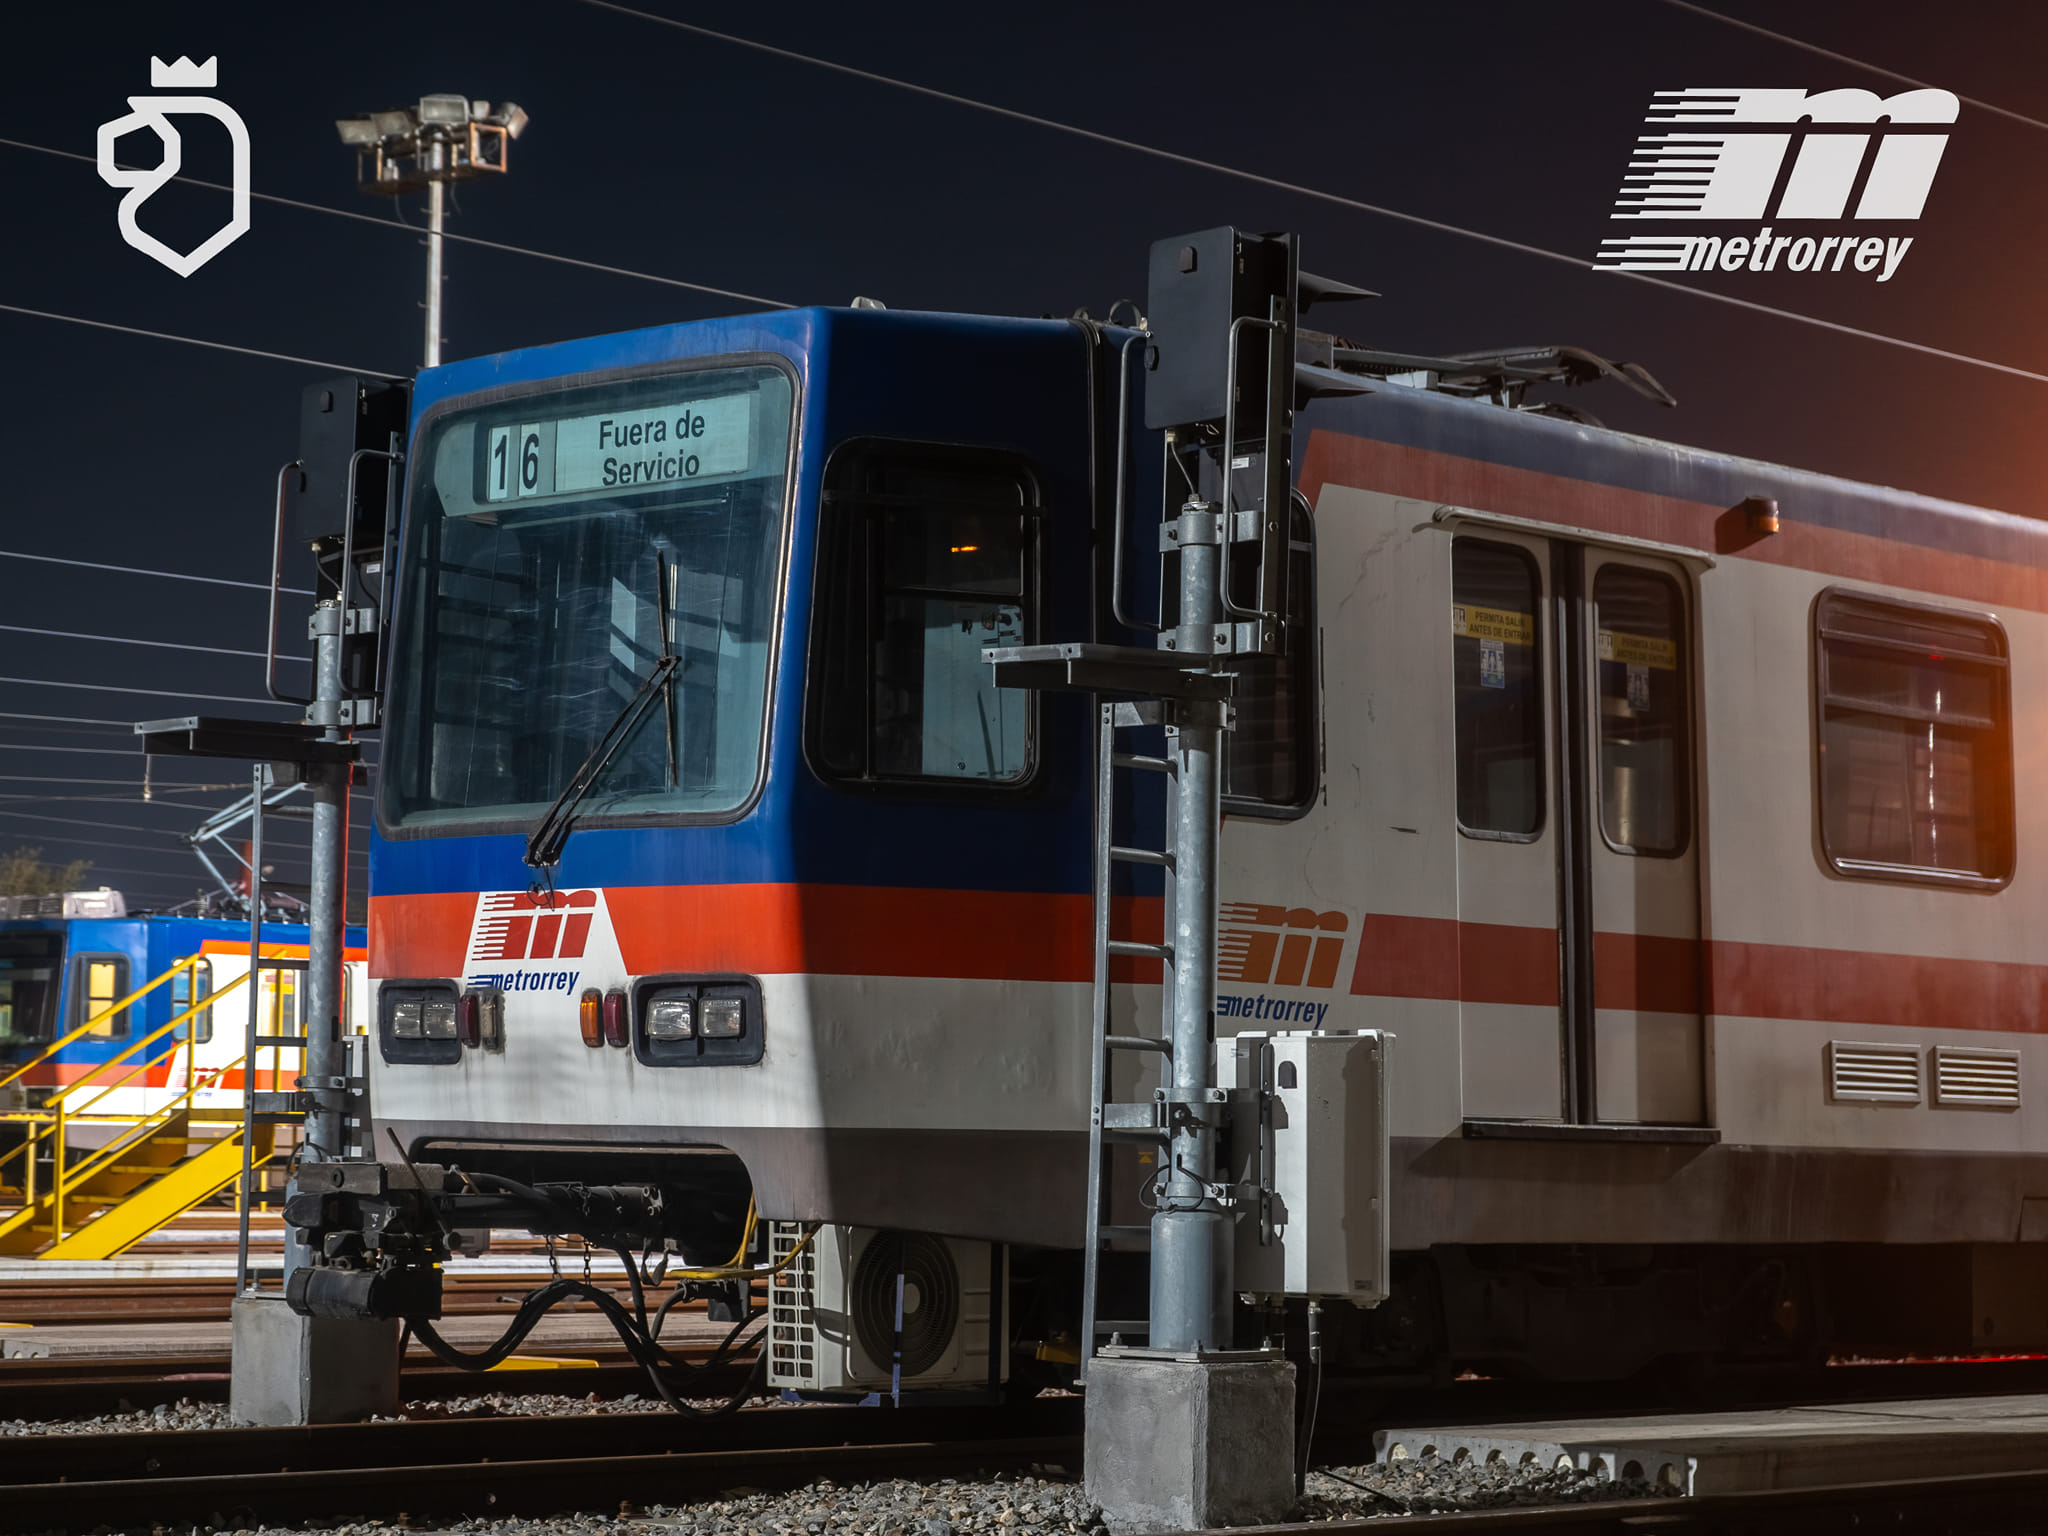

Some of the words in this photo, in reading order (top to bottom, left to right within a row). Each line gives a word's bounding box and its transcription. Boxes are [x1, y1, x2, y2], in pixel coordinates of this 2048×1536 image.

[599, 418, 667, 450] Fuera
[675, 409, 705, 440] de
[602, 448, 700, 487] Servicio
[1469, 623, 1492, 636] ANTES
[1493, 627, 1503, 638] DE
[1474, 610, 1504, 625] PERMITA
[467, 968, 580, 996] metrorrey
[1217, 993, 1328, 1030] metrorrey
